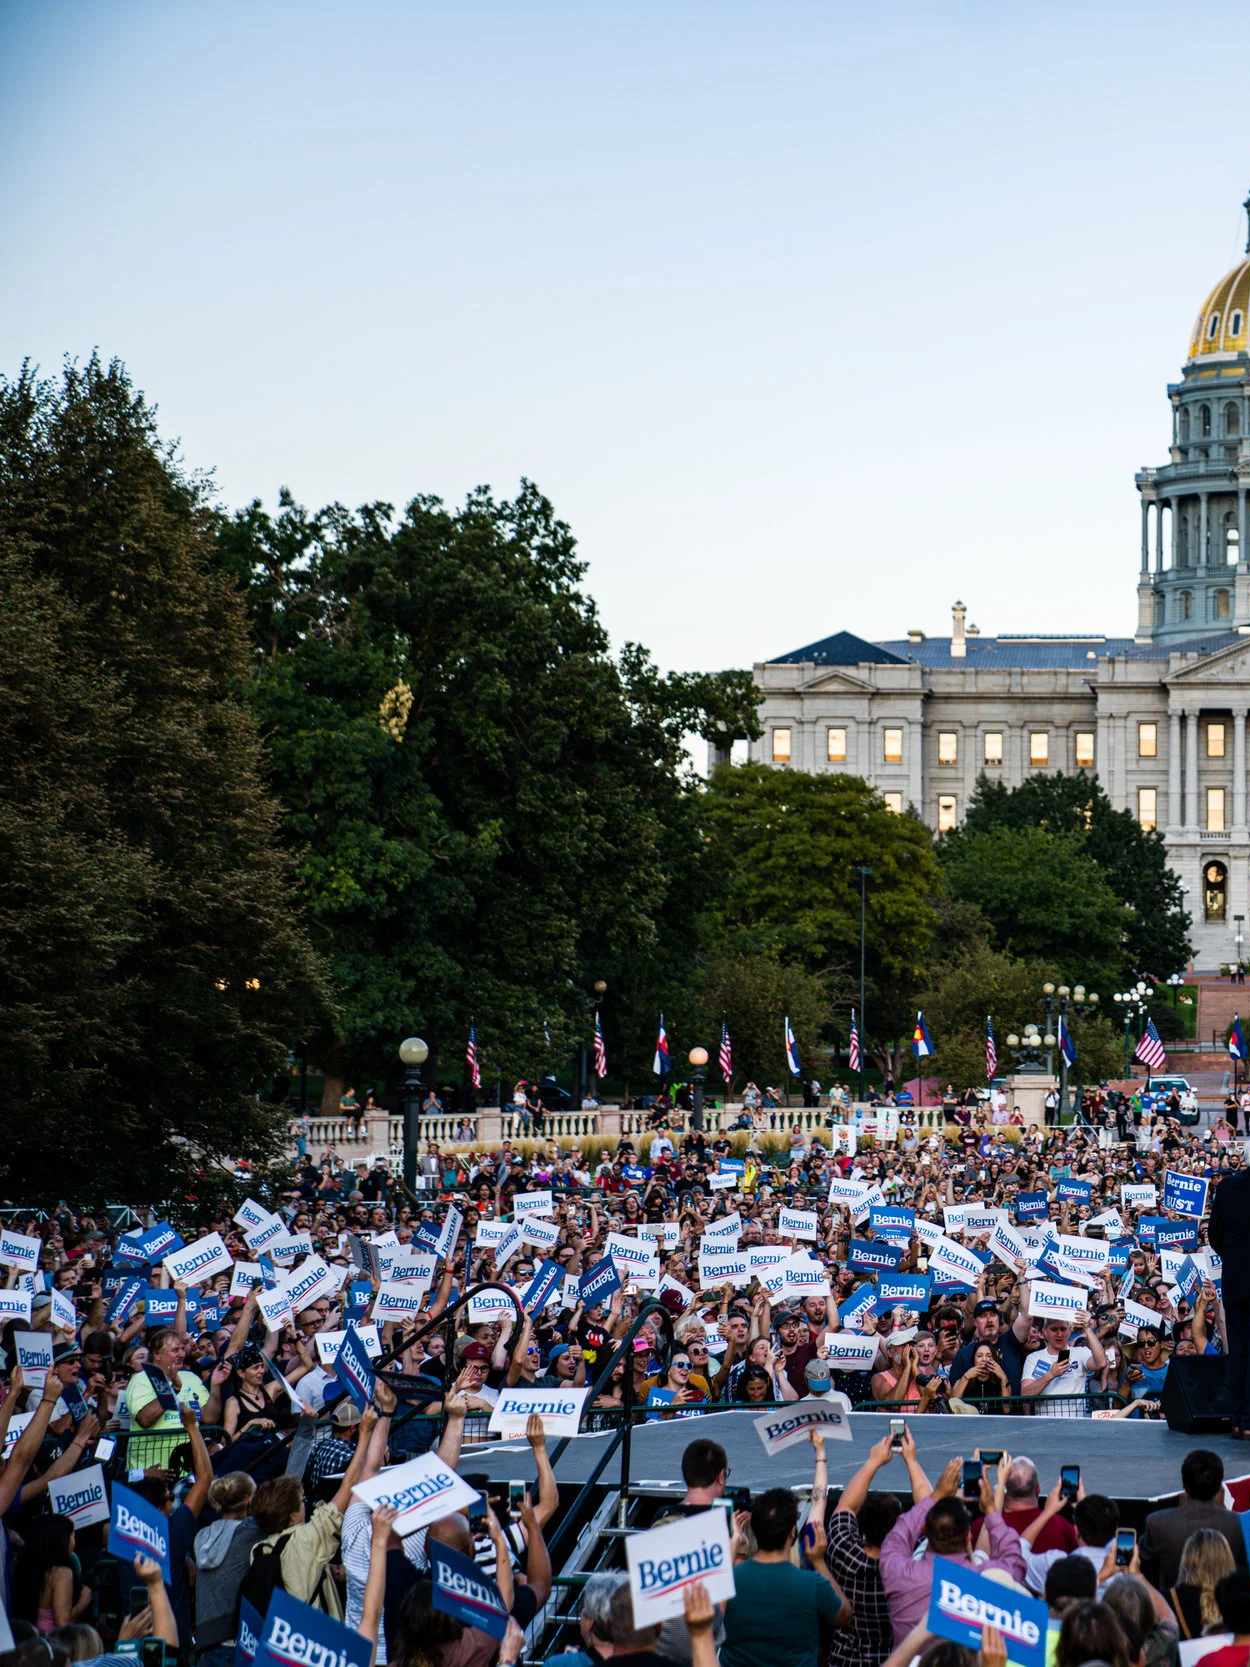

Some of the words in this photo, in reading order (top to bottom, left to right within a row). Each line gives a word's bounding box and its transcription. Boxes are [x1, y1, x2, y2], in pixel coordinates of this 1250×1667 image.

[721, 1162, 742, 1170] Bernie
[1059, 1184, 1088, 1197] Bernie
[1167, 1173, 1202, 1192] Bernie
[832, 1185, 863, 1198] Bernie
[1124, 1191, 1153, 1200] Bernie
[516, 1199, 549, 1210] Bernie
[852, 1193, 881, 1215] Bernie
[1019, 1200, 1045, 1211] Bernie
[242, 1207, 264, 1226] Bern
[782, 1216, 814, 1230] Bernie
[872, 1214, 912, 1228] Bernie
[947, 1214, 964, 1223] Ber
[967, 1216, 998, 1226] Berni
[249, 1222, 282, 1249] Bernie
[417, 1227, 437, 1244] Bern
[441, 1212, 457, 1254] Bernie
[480, 1228, 503, 1239] Bern
[523, 1224, 555, 1241] Bernie
[914, 1225, 938, 1239] ernie
[1141, 1224, 1155, 1234] Ber
[1158, 1229, 1195, 1243] Bernie
[2, 1241, 36, 1259] Bernie
[144, 1230, 175, 1256] Bernie
[274, 1243, 310, 1257] Bernie
[495, 1230, 519, 1257] Berni
[702, 1244, 735, 1254] Bernie
[995, 1226, 1023, 1257] Bernie
[120, 1243, 147, 1259] Bern
[608, 1243, 650, 1263] Bernie
[851, 1249, 896, 1266] Bernie
[937, 1245, 980, 1274] Bernie
[1063, 1244, 1105, 1260] Bernie
[1108, 1253, 1127, 1263] nie
[173, 1245, 223, 1277] Bernie
[379, 1257, 393, 1270] Ber
[703, 1262, 746, 1277] Bernie
[392, 1264, 430, 1278] Bernie
[785, 1270, 824, 1282] Bernie
[288, 1266, 327, 1303] Bernie
[581, 1266, 616, 1298] Bernie
[880, 1283, 925, 1299] Bernie
[0, 1300, 27, 1312] rnie
[379, 1293, 418, 1310] Bernie
[843, 1294, 878, 1321] ernie
[1034, 1291, 1082, 1309] Bernie
[1125, 1312, 1149, 1326] erni
[20, 1347, 51, 1367] Bernie
[829, 1345, 873, 1358] Bernie
[341, 1340, 372, 1400] Bernie
[501, 1400, 576, 1415] Bernie
[765, 1409, 842, 1439] Bernie
[55, 1483, 103, 1513] Bernie
[116, 1504, 166, 1557] Bernie
[637, 1540, 723, 1590] Bernie
[437, 1560, 500, 1611] Berni
[940, 1579, 1040, 1646] Bernie
[241, 1620, 257, 1649] Ber
